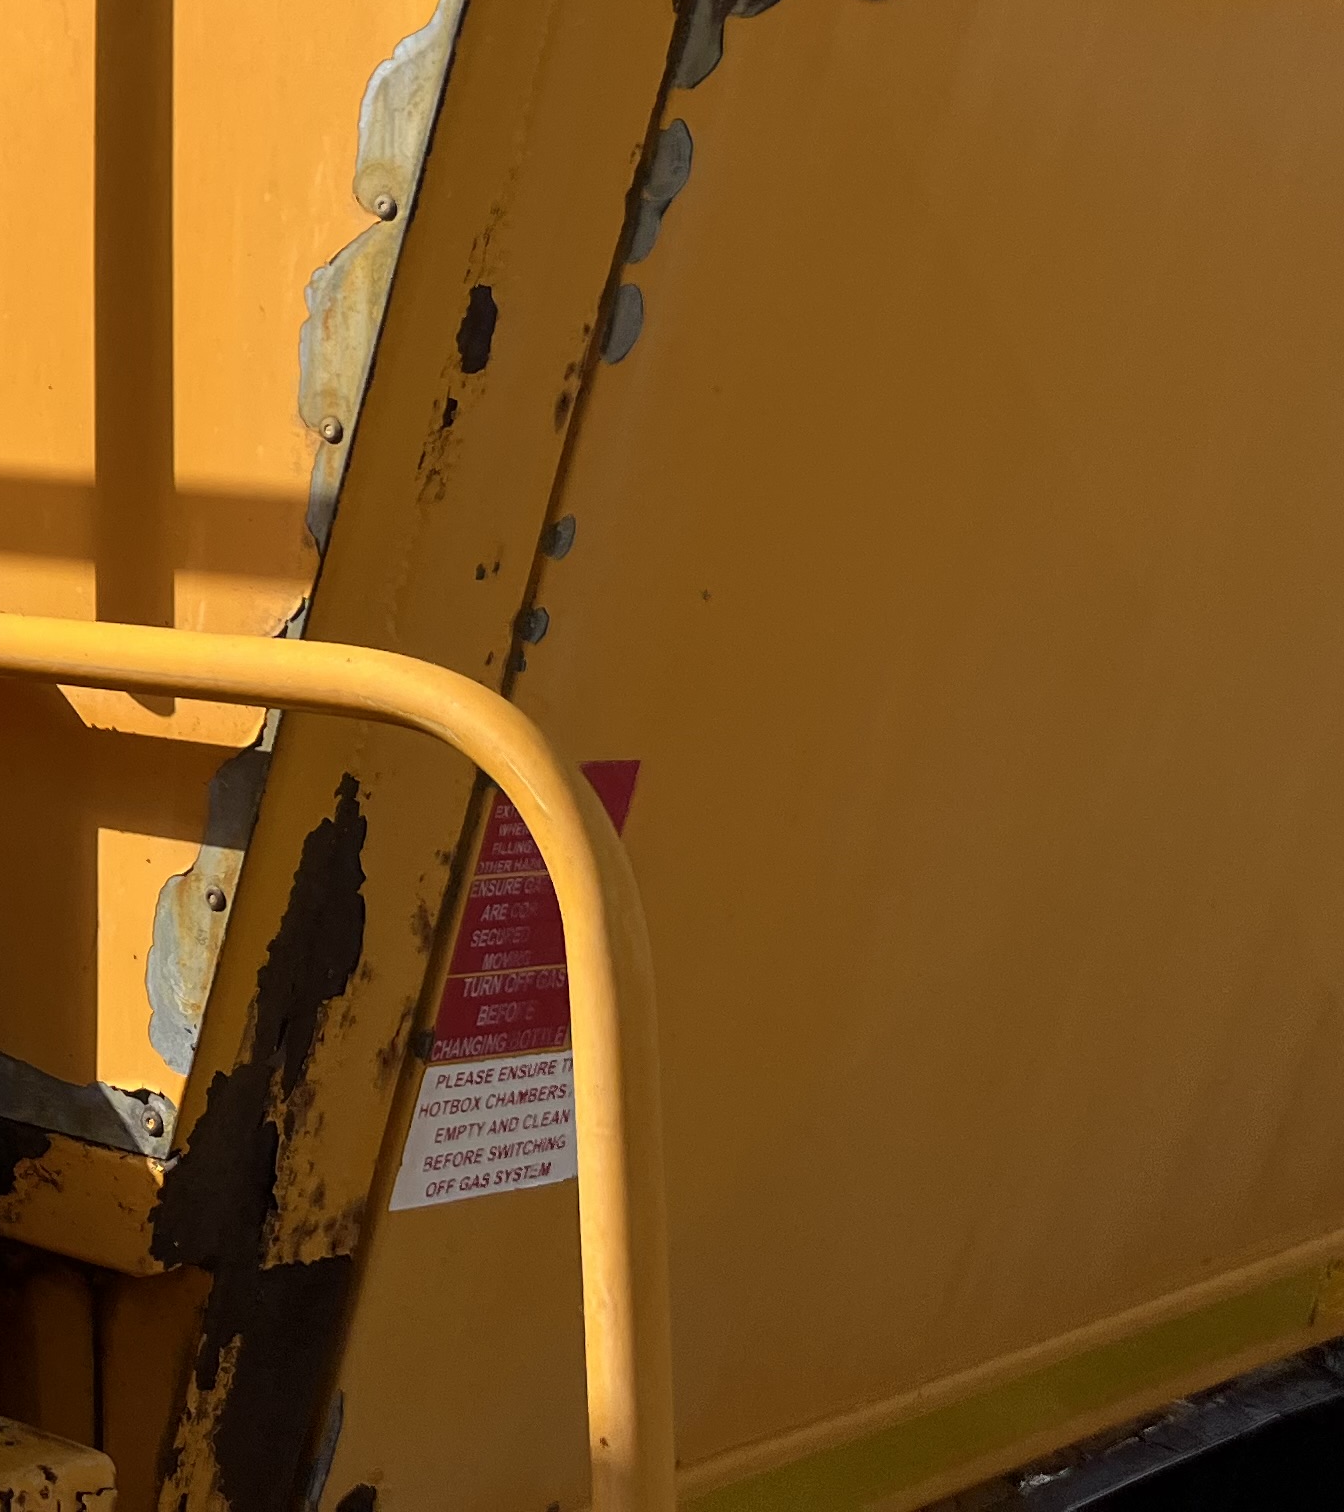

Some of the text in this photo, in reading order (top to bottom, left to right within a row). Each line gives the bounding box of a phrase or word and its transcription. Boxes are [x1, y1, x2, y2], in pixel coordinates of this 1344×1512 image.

[470, 878, 523, 897] ENSURE
[480, 903, 508, 922] ARE
[463, 969, 566, 998] TURN OFF GAS
[431, 1033, 508, 1060] CHANGING
[436, 1068, 495, 1089] PLEASE
[498, 1060, 558, 1082] ENSURE
[418, 1084, 567, 1119] HOTBOX CHAMBERS
[434, 1109, 571, 1144] EMPTY AND CLEAN
[423, 1134, 566, 1172] BEFORE SWITCHING
[426, 1161, 552, 1198] OFF GAS SYSTEM
